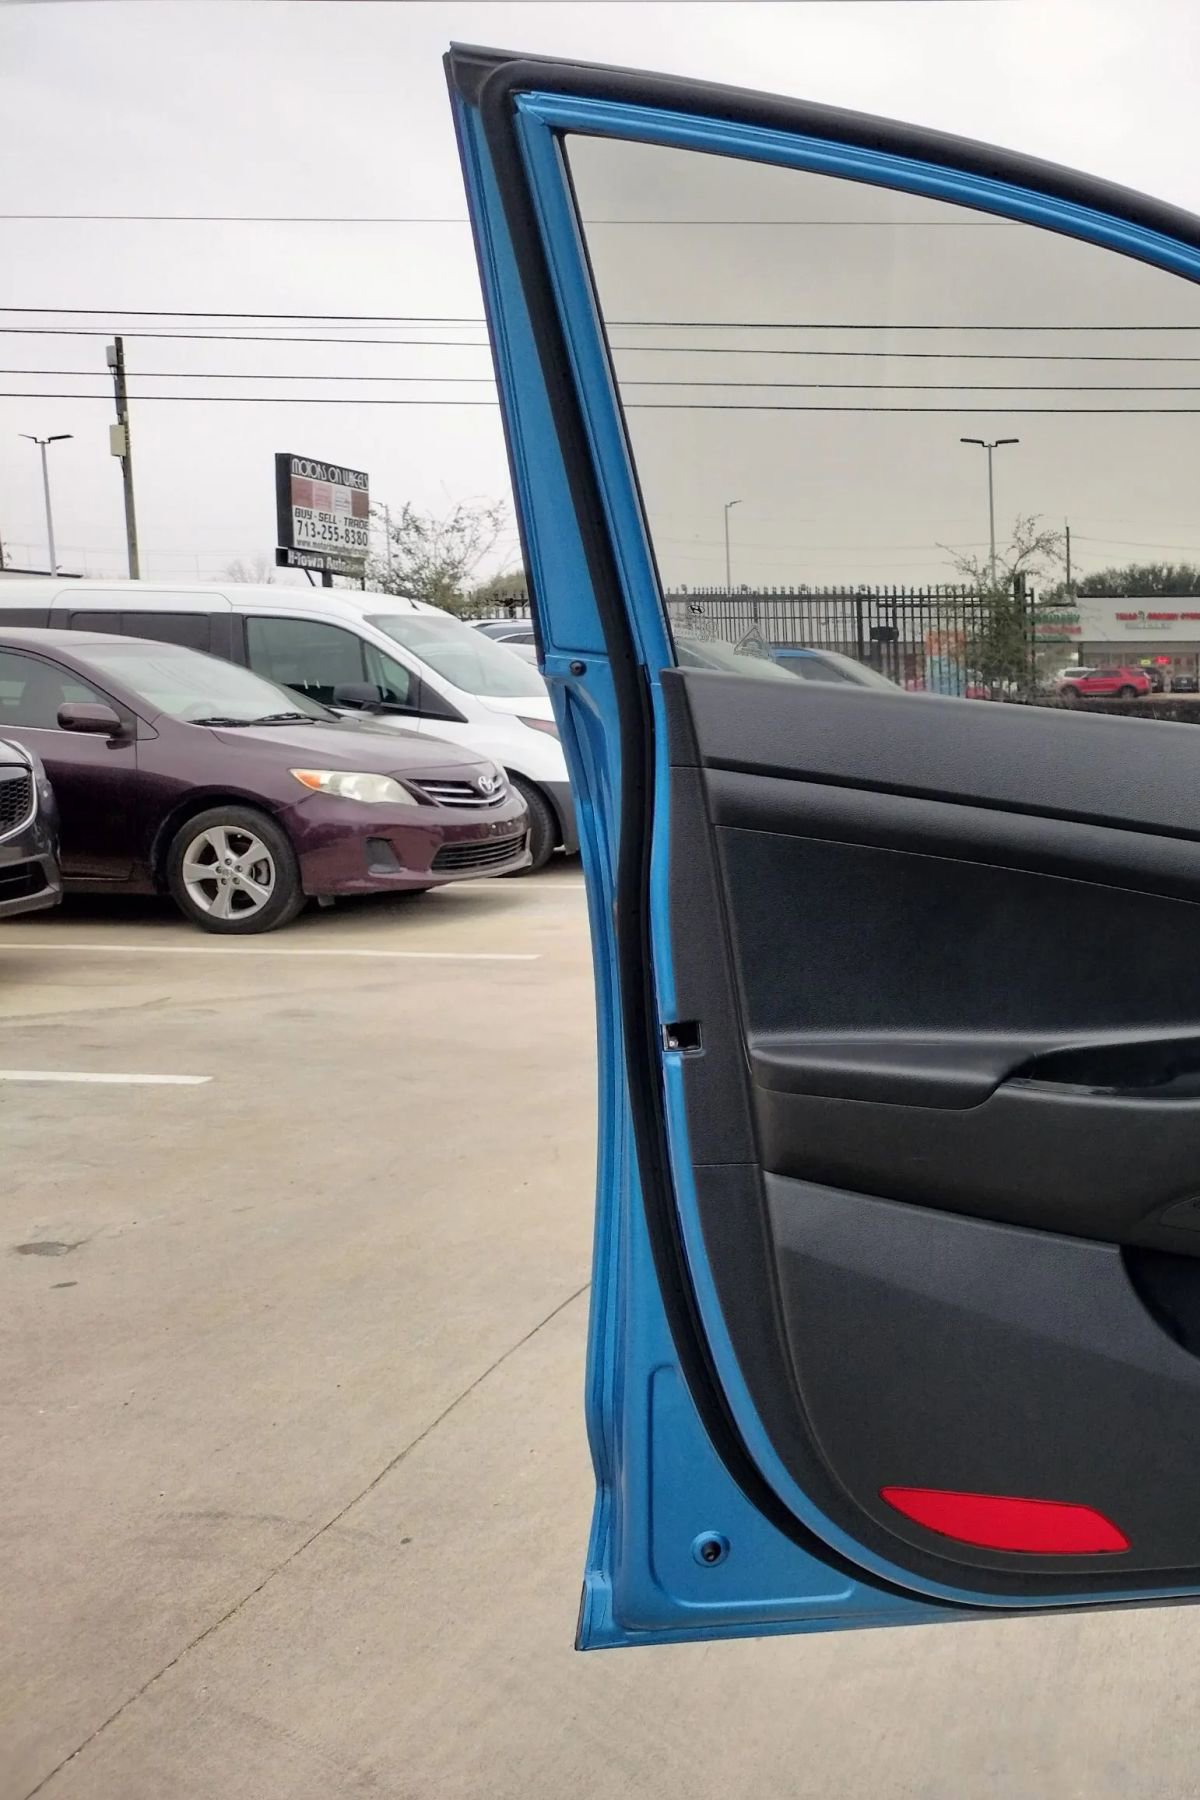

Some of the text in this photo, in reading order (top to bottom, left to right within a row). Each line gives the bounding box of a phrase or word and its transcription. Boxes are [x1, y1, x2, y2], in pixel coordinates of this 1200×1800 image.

[294, 507, 369, 530] BUY SELL TRADE
[296, 520, 368, 546] 713-255-8380
